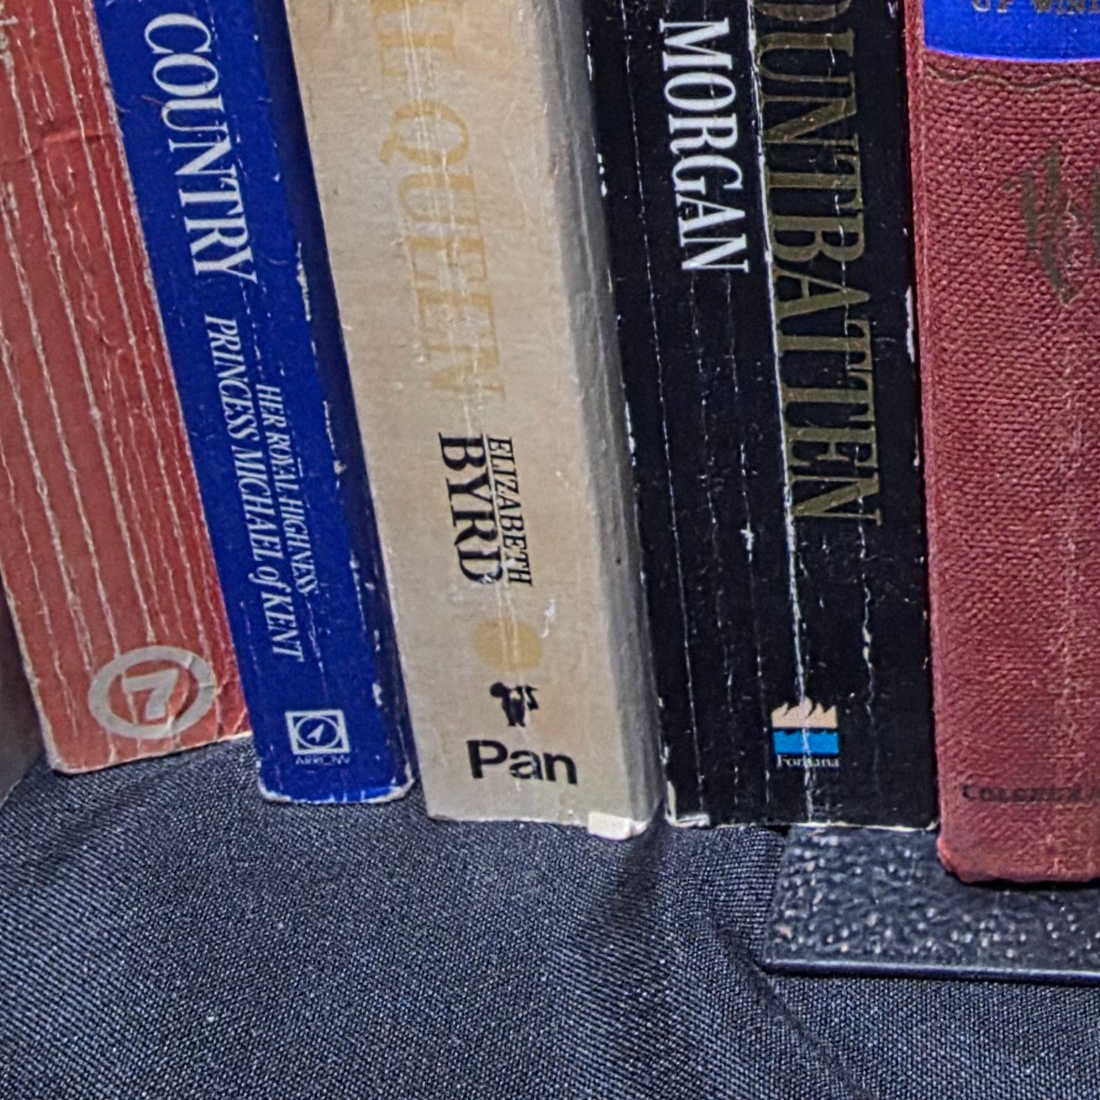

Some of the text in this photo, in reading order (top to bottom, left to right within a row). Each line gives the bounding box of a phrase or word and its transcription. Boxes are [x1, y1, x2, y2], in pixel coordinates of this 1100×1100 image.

[144, 12, 259, 284] COUNTRY
[379, 100, 507, 399] QUEEN
[659, 17, 751, 275] MORGAN
[204, 312, 305, 663] PRINCESS MICHAEL of KENT
[256, 383, 320, 597] HER ROYAL HIGHNESS
[438, 431, 503, 585] BYRD
[485, 435, 534, 588] ELIZABETH
[465, 738, 578, 786] Pan
